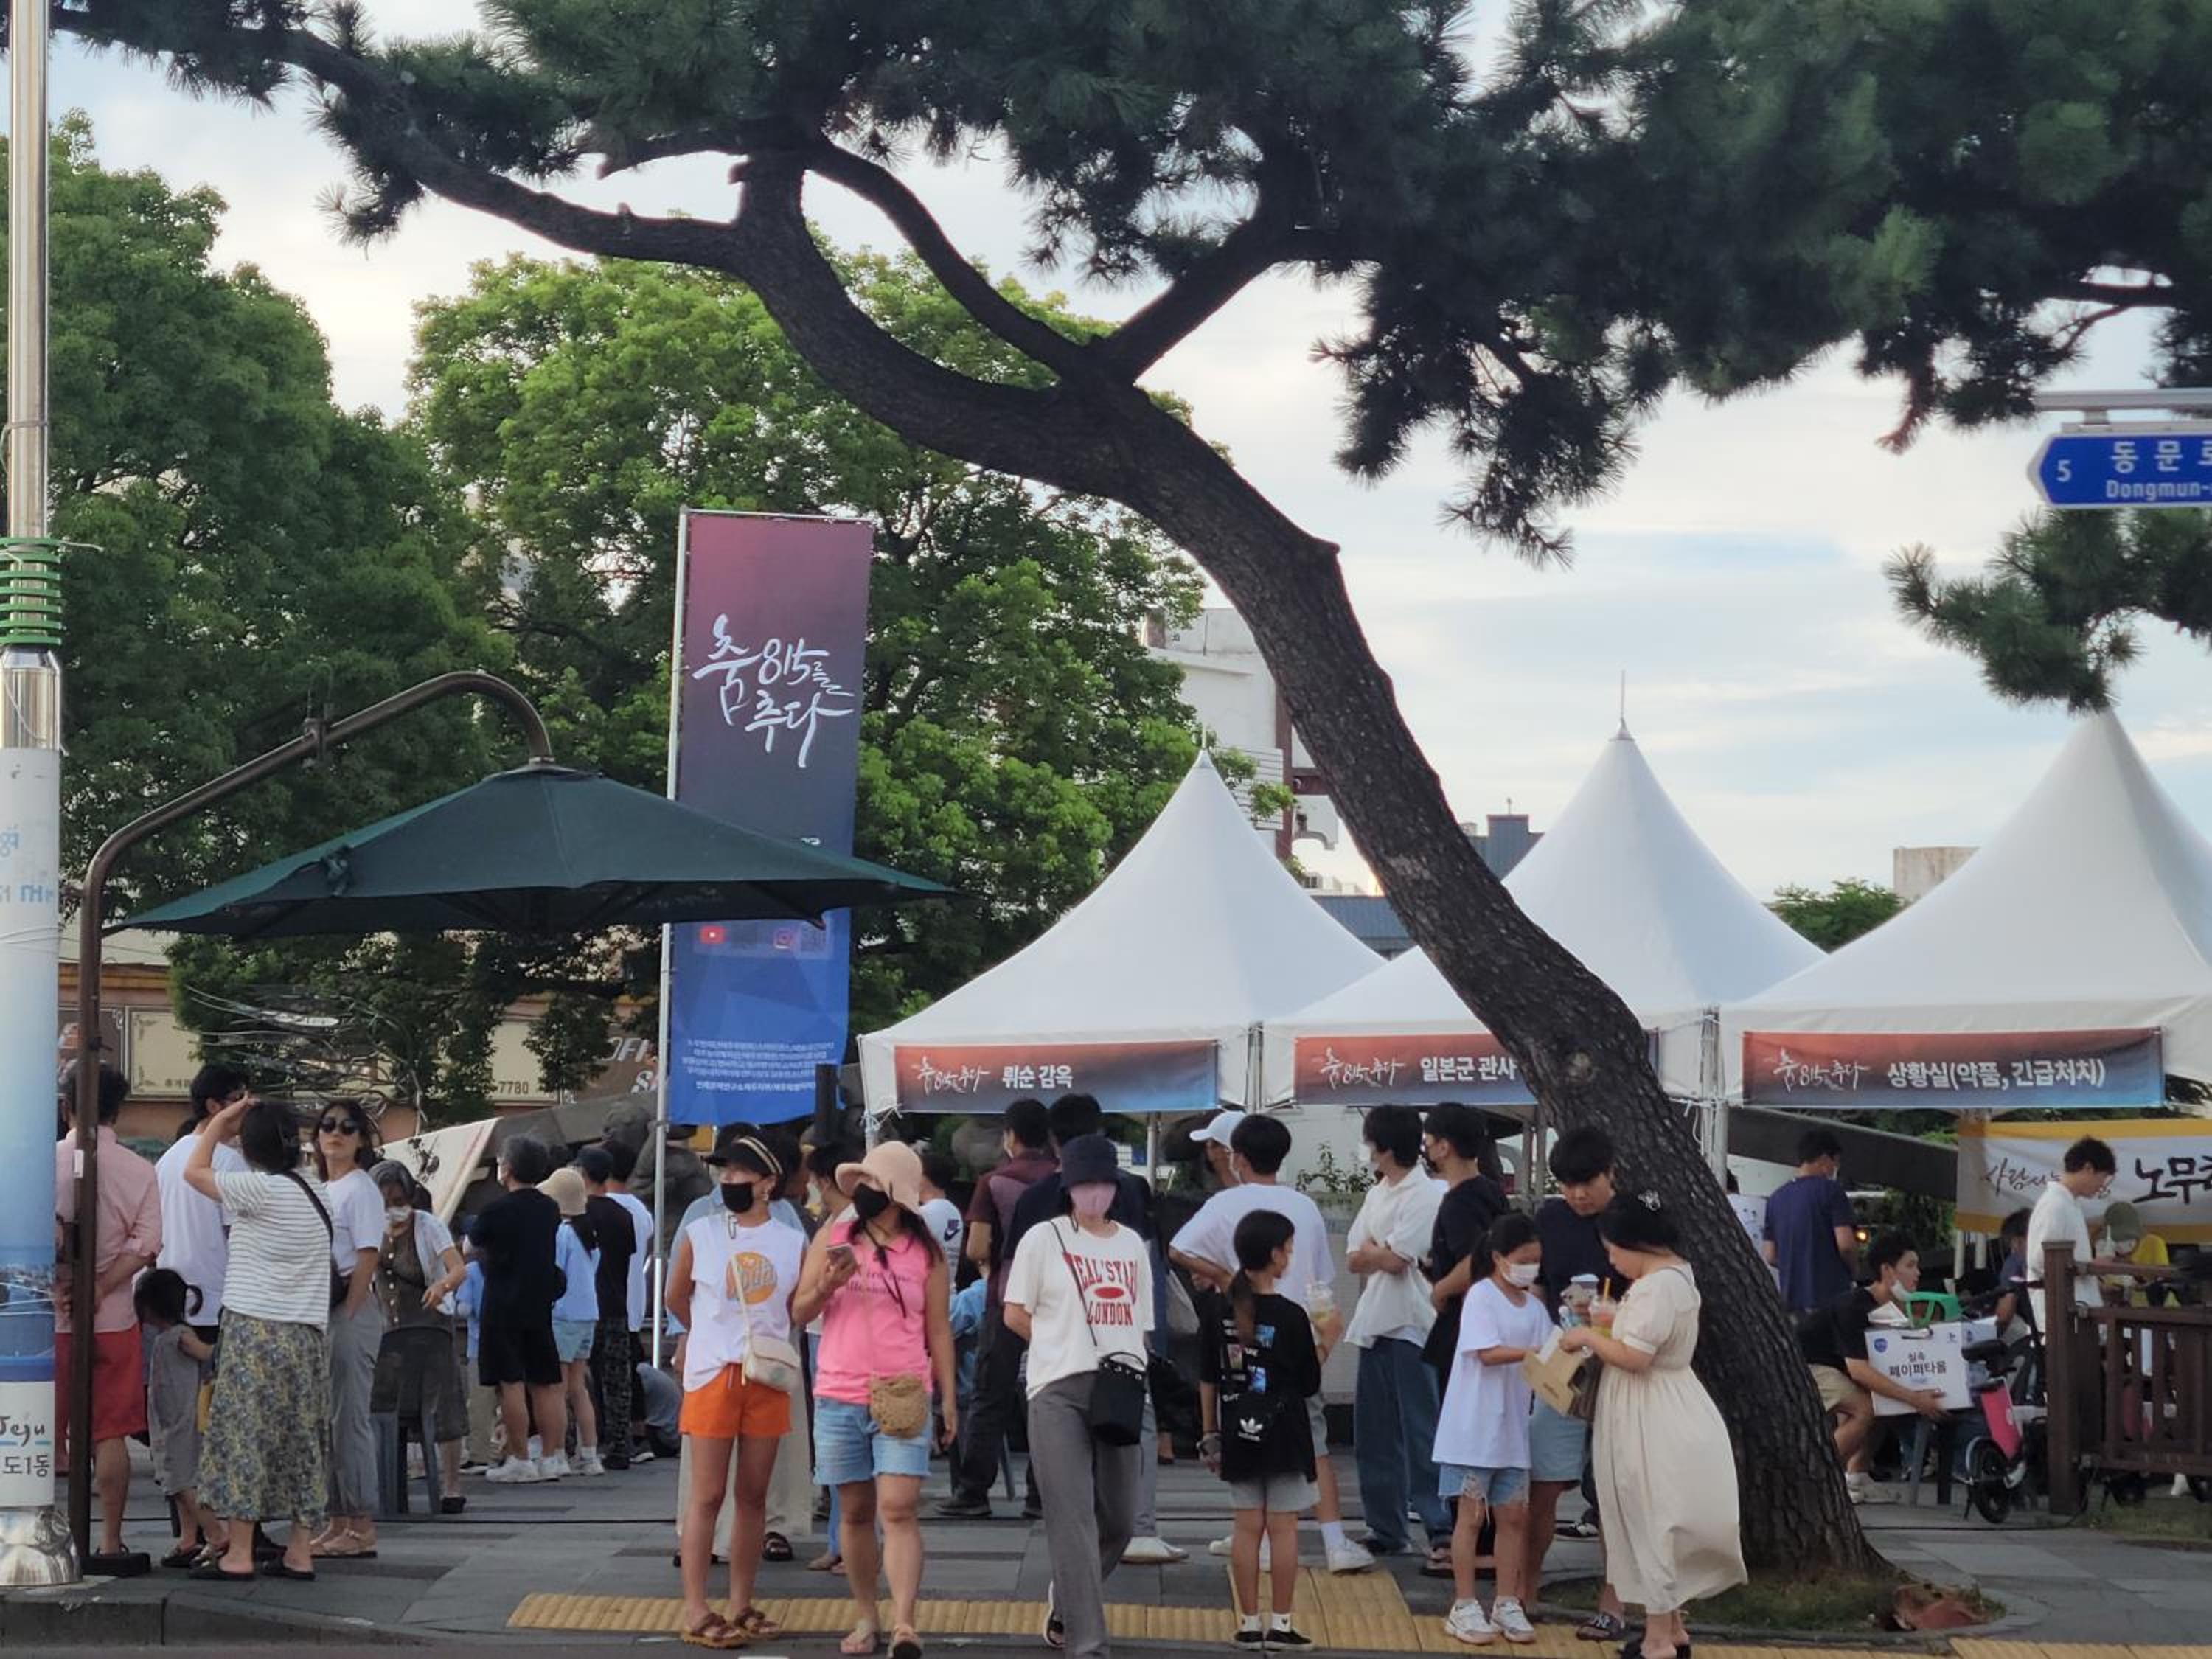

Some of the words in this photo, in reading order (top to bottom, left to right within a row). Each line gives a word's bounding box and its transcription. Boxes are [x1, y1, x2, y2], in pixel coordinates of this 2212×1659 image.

[2056, 460, 2071, 481] 5
[2106, 480, 2212, 501] Dongmun-
[745, 689, 854, 768] 추다
[1002, 1065, 1035, 1089] 뤼순
[1038, 1065, 1074, 1089] 감옥
[1420, 1057, 1475, 1082] 일본군
[1478, 1055, 1518, 1081] 관사
[1887, 1062, 2009, 1090] 상황실(약품,
[2011, 1059, 2106, 1088] 긴급처치)
[1086, 1301, 1133, 1325] LONDON
[3, 1455, 49, 1477] 도1동
